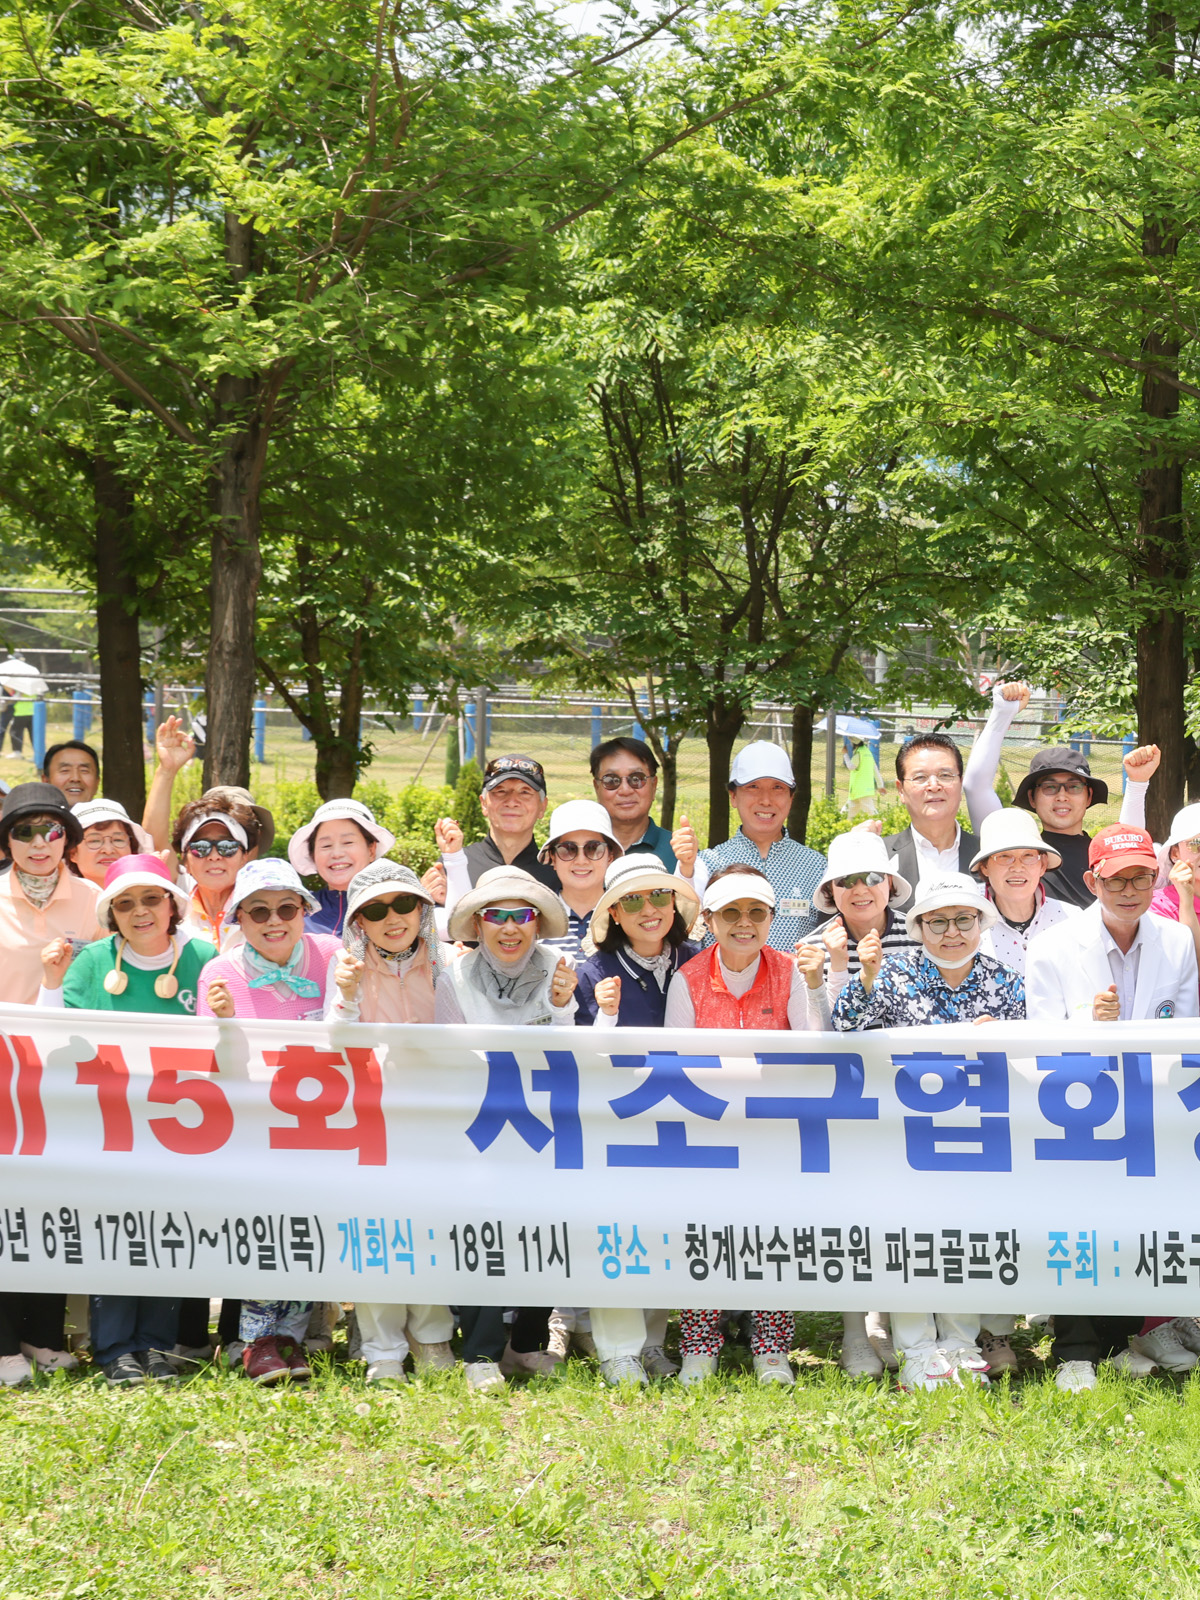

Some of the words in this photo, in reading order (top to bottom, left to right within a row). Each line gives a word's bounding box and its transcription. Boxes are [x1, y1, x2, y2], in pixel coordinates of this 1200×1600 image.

[0, 1208, 29, 1262] 년
[43, 1207, 82, 1264] 6월
[95, 1211, 324, 1273] 17일(수)~18일(목)
[338, 1217, 415, 1275] 개회식
[450, 1221, 505, 1276] 18일
[519, 1222, 570, 1278] 11시
[597, 1222, 651, 1279] 장소
[685, 1224, 872, 1282] 청계산수변공원
[886, 1228, 1019, 1285] 파크골프장
[1047, 1230, 1098, 1287] 주최
